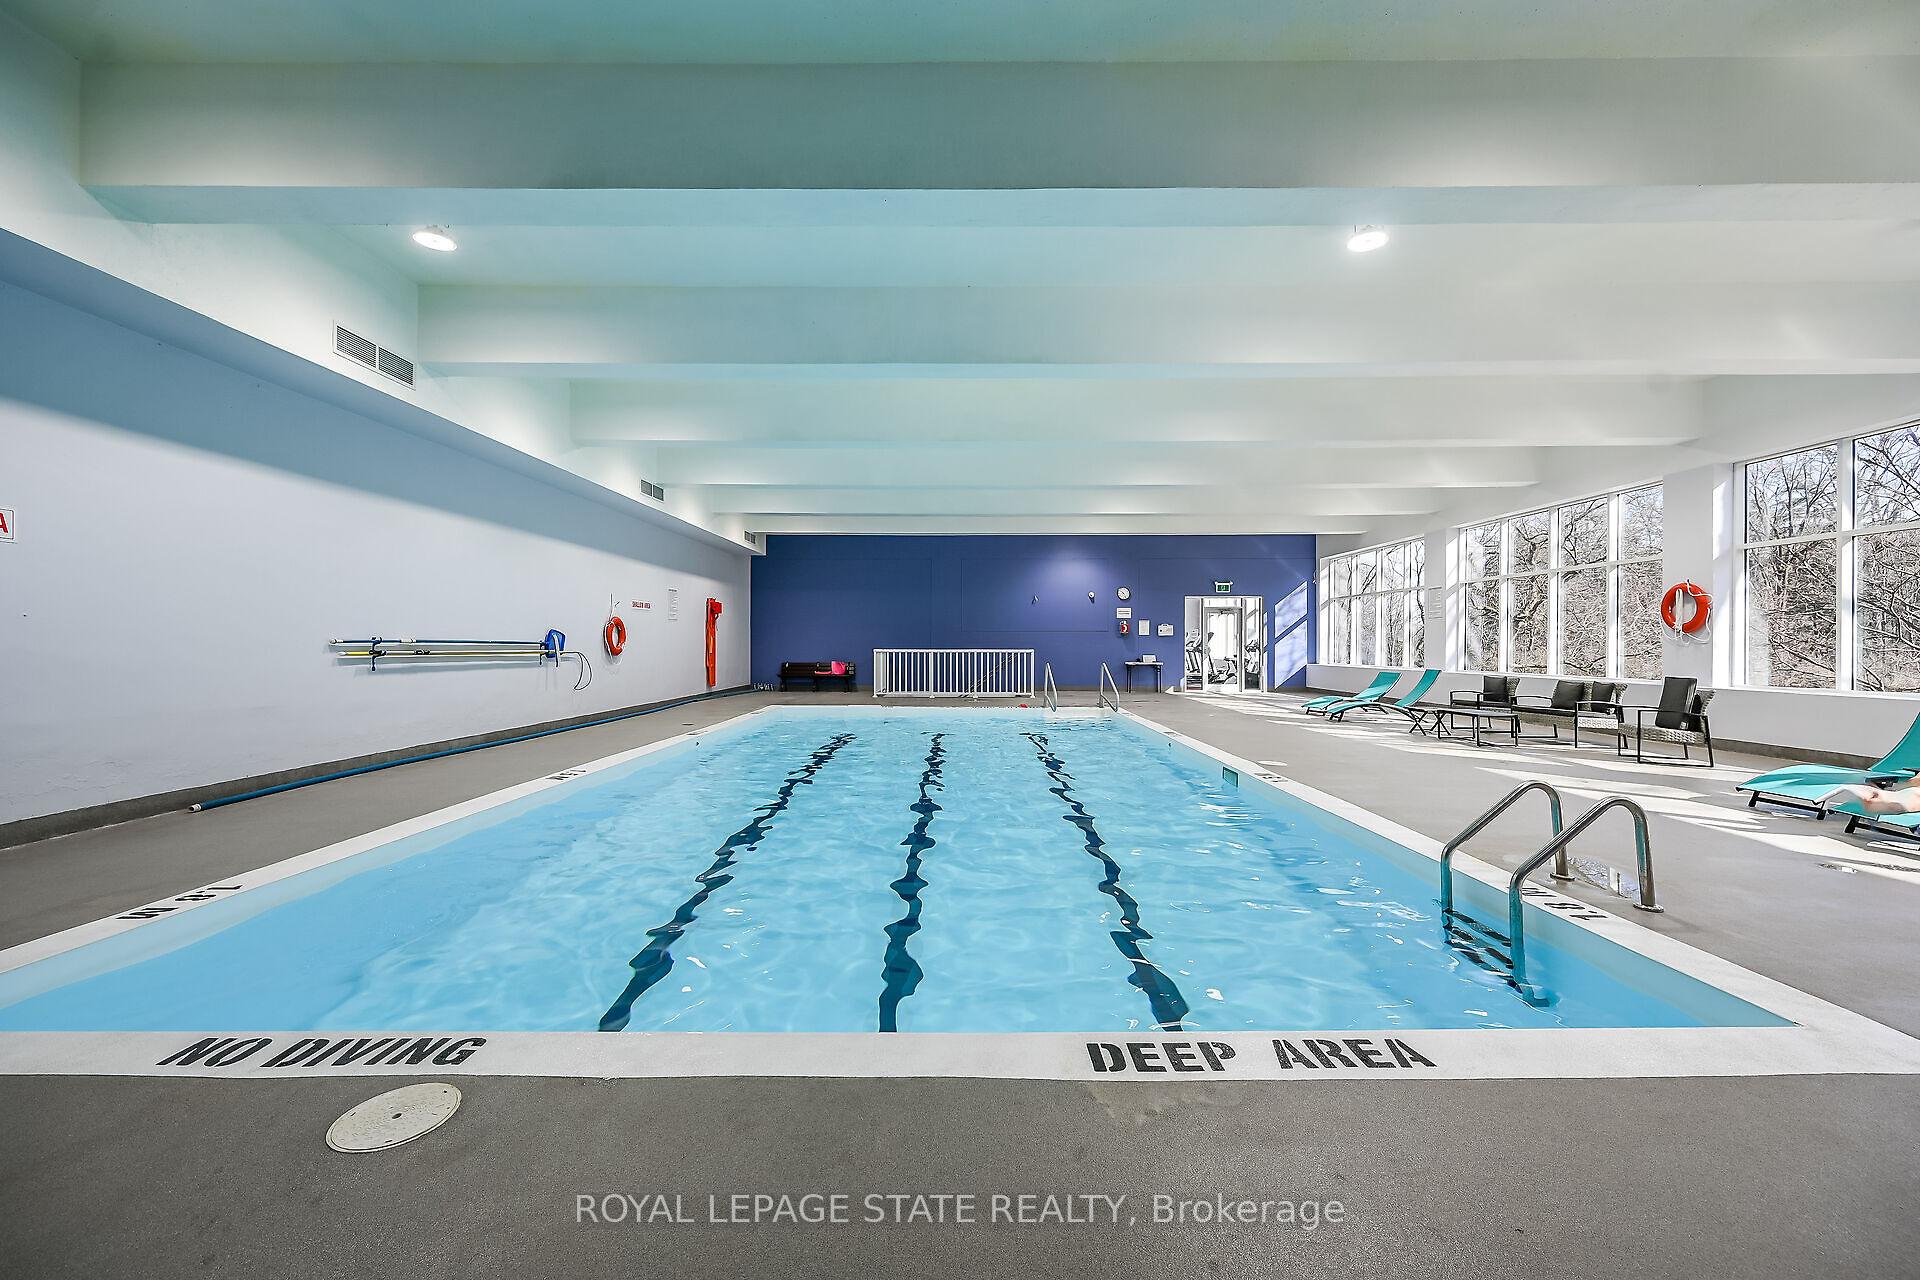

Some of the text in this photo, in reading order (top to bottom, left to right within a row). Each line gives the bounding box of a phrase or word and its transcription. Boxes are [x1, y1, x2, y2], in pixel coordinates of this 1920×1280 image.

[156, 1036, 487, 1068] NO DIVING
[1087, 1039, 1437, 1073] DEEP AREA
